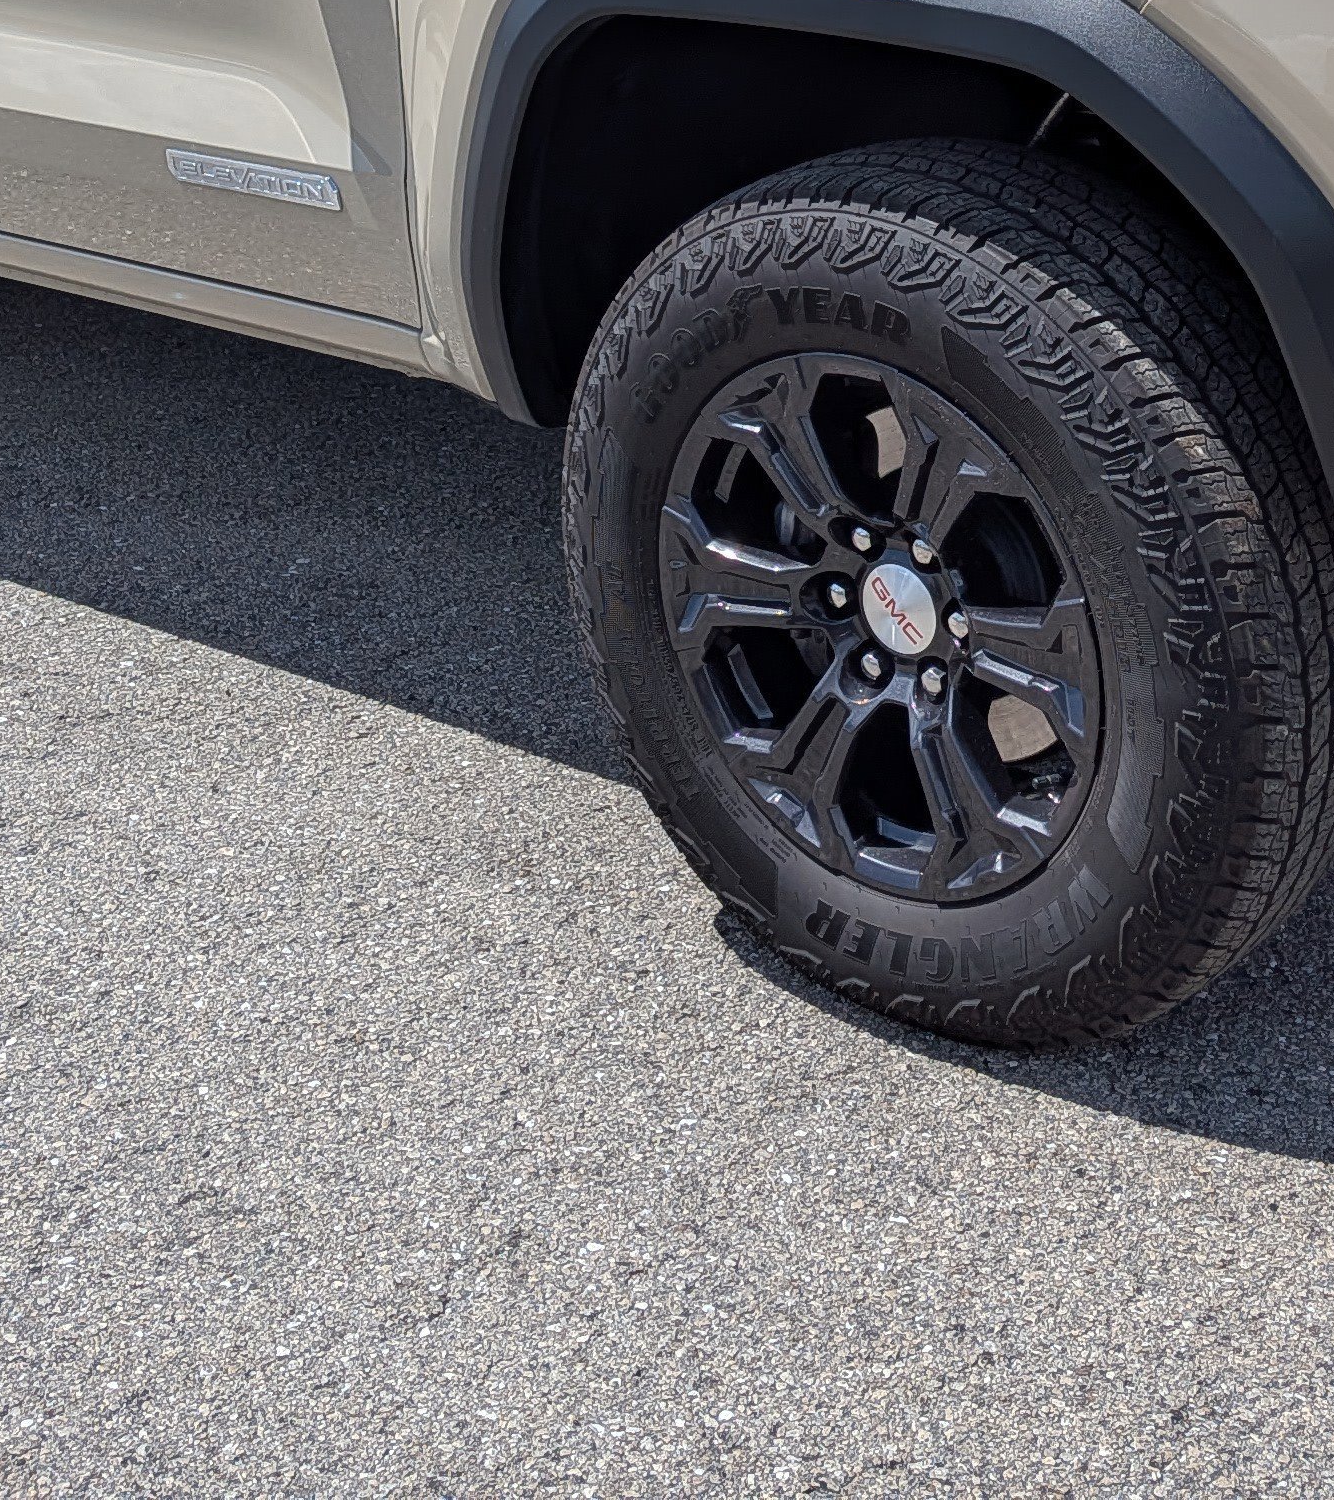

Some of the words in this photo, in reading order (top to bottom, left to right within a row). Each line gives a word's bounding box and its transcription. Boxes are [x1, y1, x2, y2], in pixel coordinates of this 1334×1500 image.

[178, 159, 324, 201] ELEVATION
[871, 576, 924, 646] GMC
[804, 863, 1113, 985] WRANGLER
